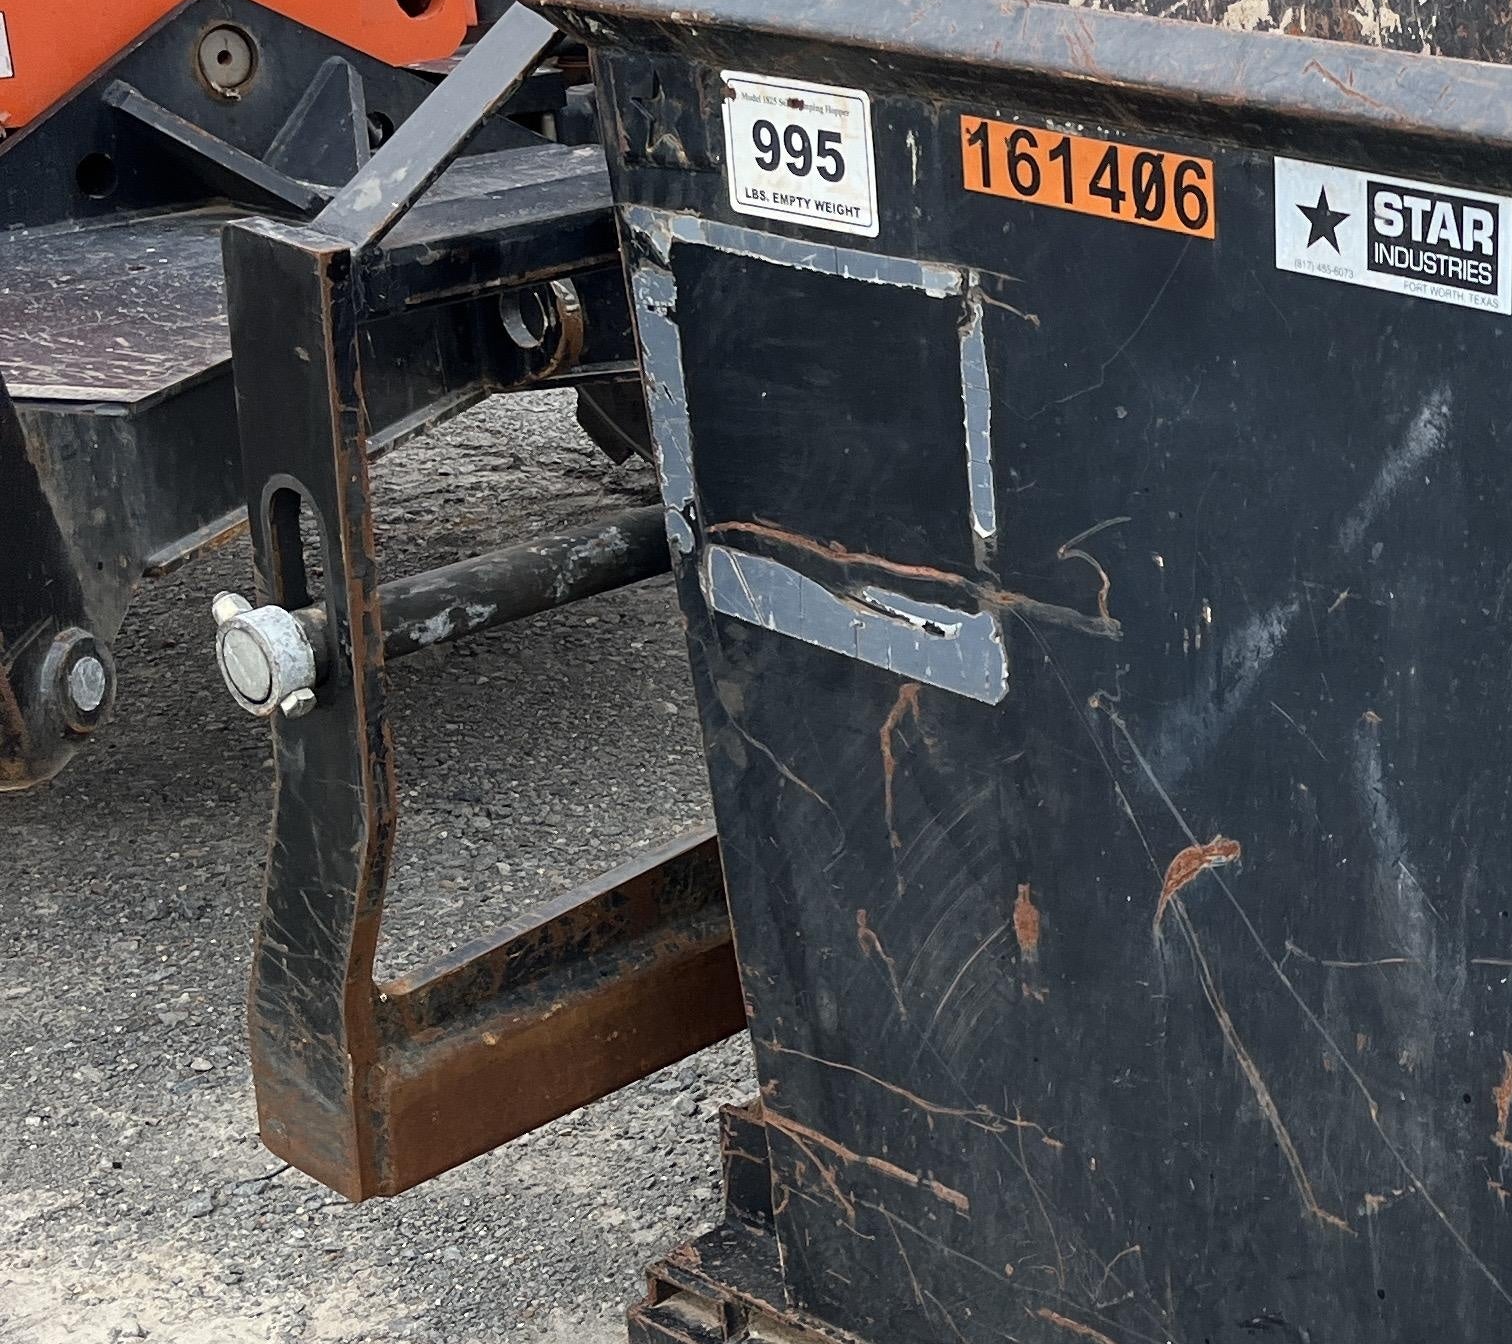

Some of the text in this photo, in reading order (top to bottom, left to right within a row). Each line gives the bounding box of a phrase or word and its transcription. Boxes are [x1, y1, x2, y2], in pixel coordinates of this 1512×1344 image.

[751, 118, 846, 183] 995
[966, 120, 1211, 231] 161406
[745, 187, 862, 221] LBS. EMPTY WEIGHT
[1373, 189, 1494, 257] STAR
[1374, 241, 1493, 286] INDUSTRIES
[1403, 279, 1429, 294] FORT
[1469, 291, 1500, 310] TEXAS
